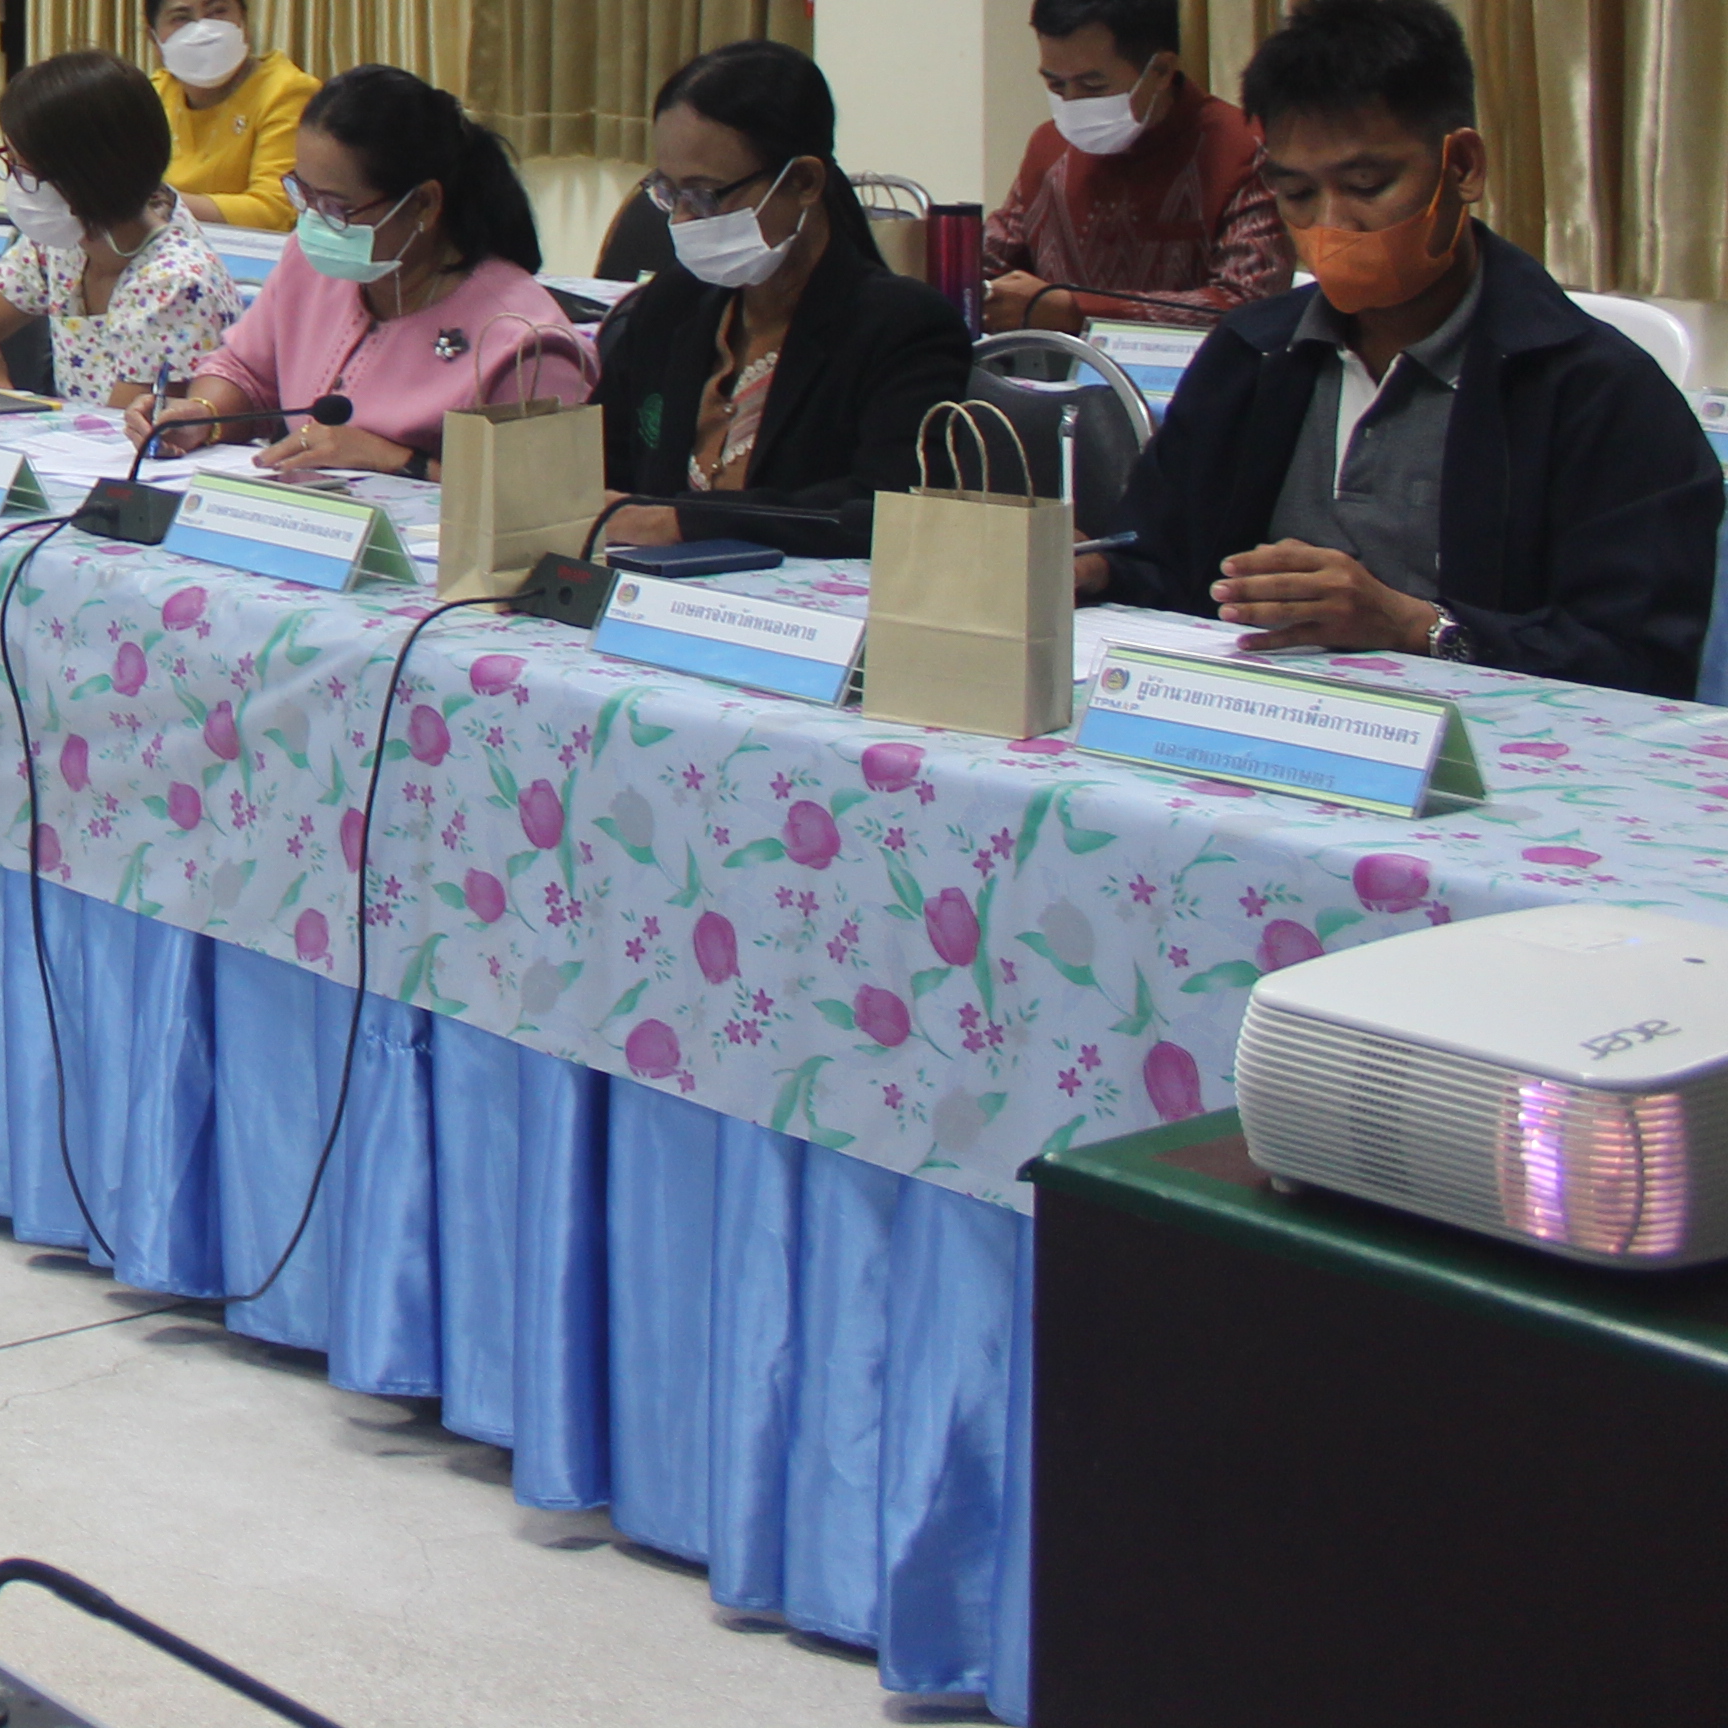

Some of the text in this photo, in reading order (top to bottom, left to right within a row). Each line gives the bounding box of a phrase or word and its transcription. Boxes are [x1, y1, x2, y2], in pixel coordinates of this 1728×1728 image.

[670, 600, 818, 641] เกษตรจังหวัดหนองคาย
[1136, 674, 1422, 746] ผู้อำนวยการธนาคารเพื่อการเกษตร
[1153, 740, 1336, 789] และสหกรณ์การเกษตร
